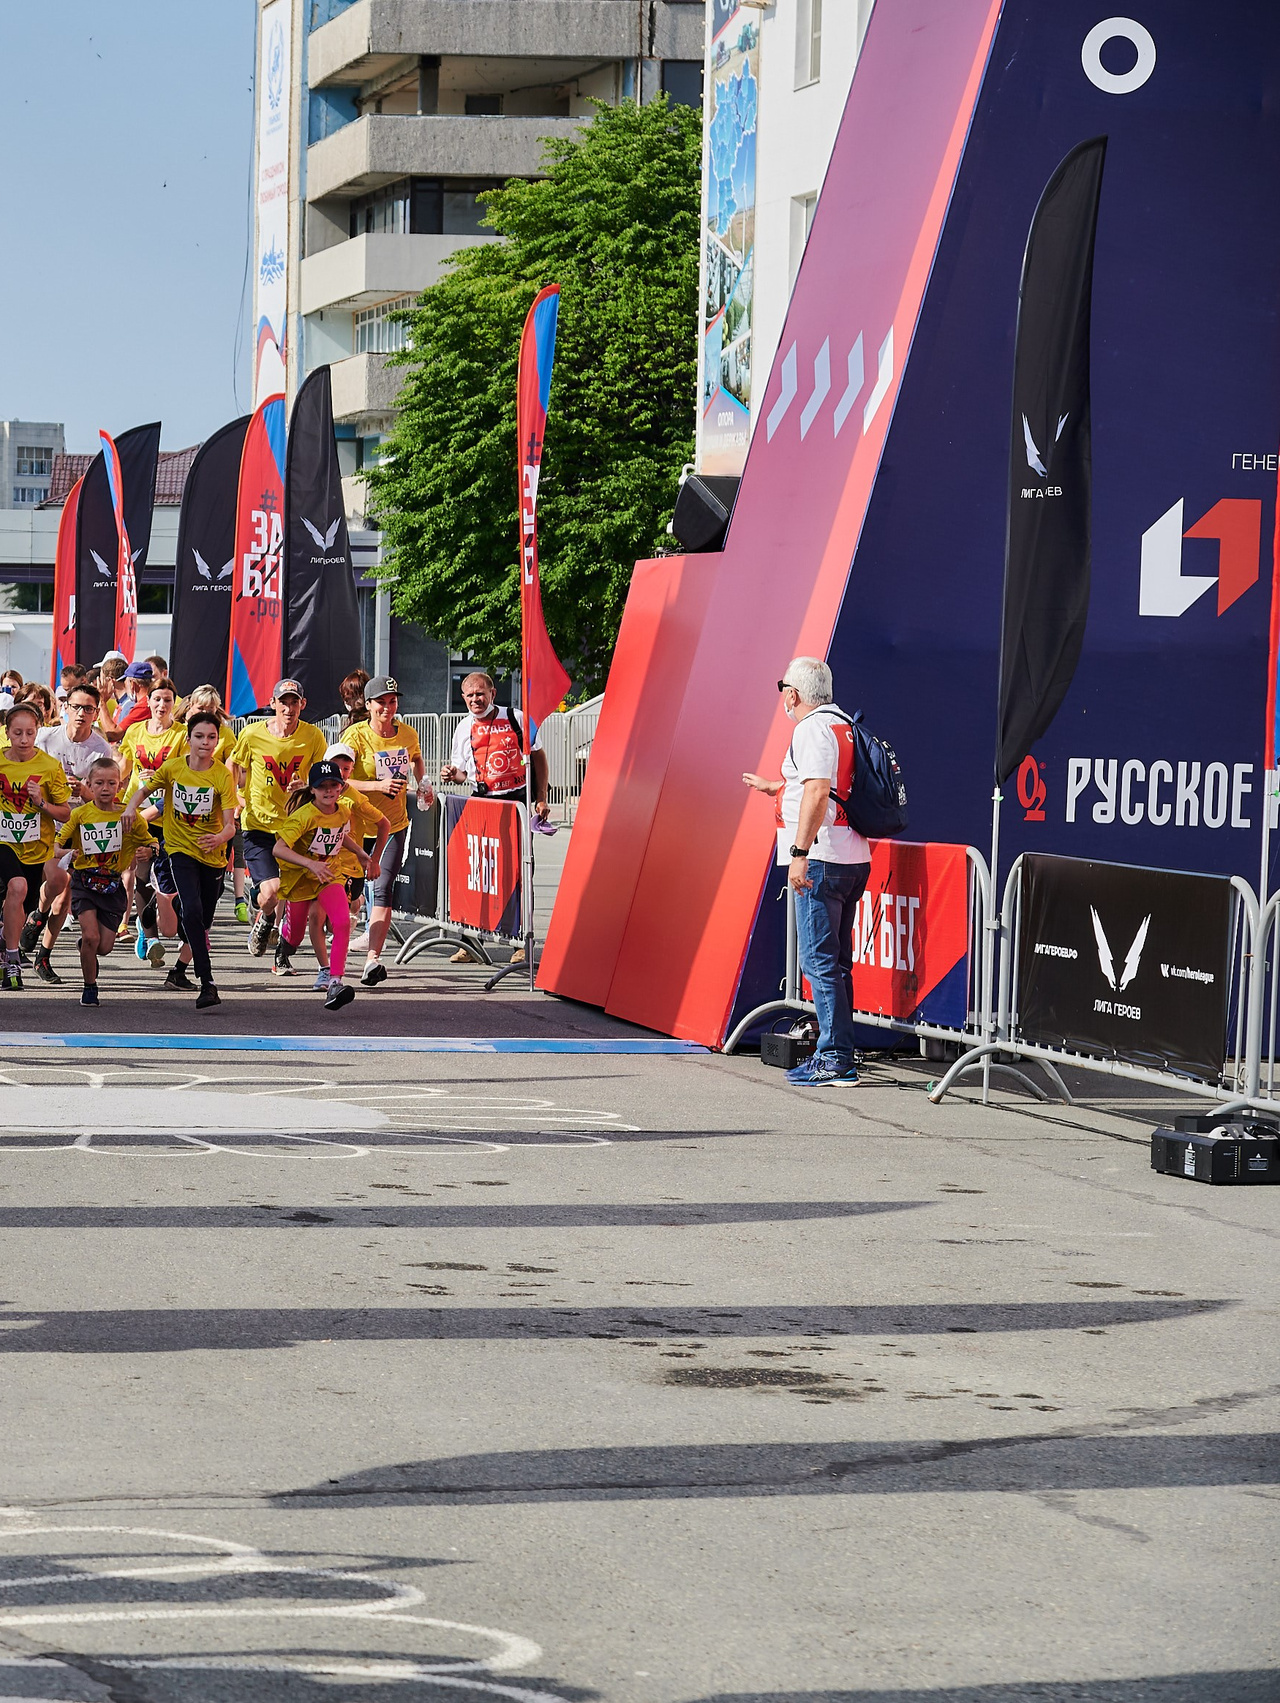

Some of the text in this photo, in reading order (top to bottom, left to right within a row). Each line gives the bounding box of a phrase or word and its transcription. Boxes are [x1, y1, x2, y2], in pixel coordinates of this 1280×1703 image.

[477, 724, 512, 736] СУДЬЯ
[265, 761, 300, 771] ONE
[378, 755, 408, 767] 10256
[266, 775, 300, 787] RU
[174, 789, 210, 803] 00145
[1065, 757, 1254, 829] РУССКОЕ
[1, 819, 38, 831] 00093
[83, 828, 119, 841] 00131
[1093, 999, 1141, 1020] ЛИГА ГЕРОЕВ
